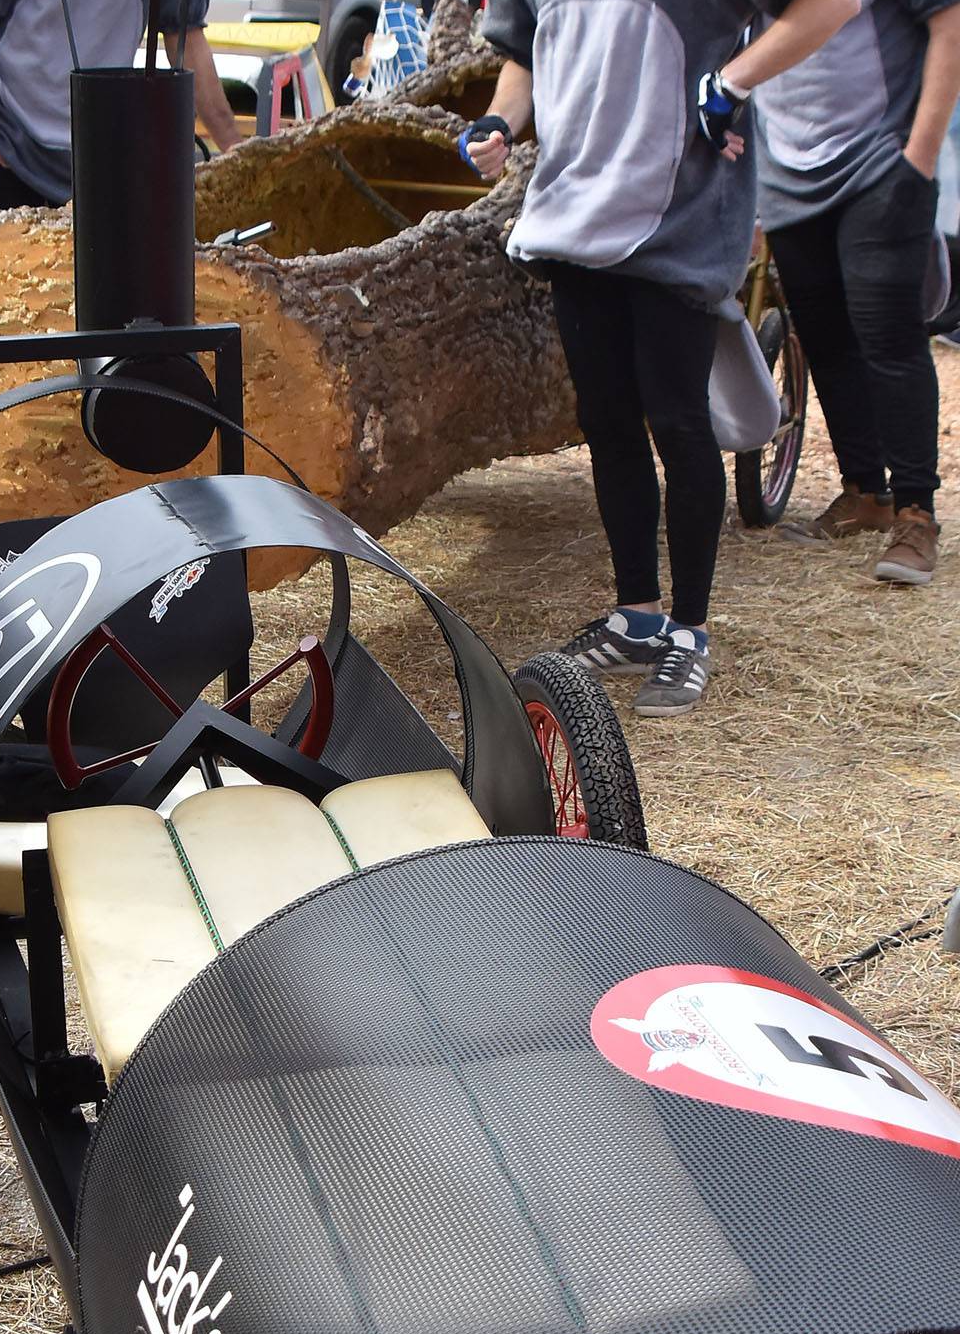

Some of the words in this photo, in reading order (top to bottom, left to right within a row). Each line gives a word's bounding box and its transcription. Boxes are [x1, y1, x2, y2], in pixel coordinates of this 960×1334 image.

[156, 594, 166, 605] RED
[163, 584, 174, 597] BULL
[755, 1023, 929, 1102] 5
